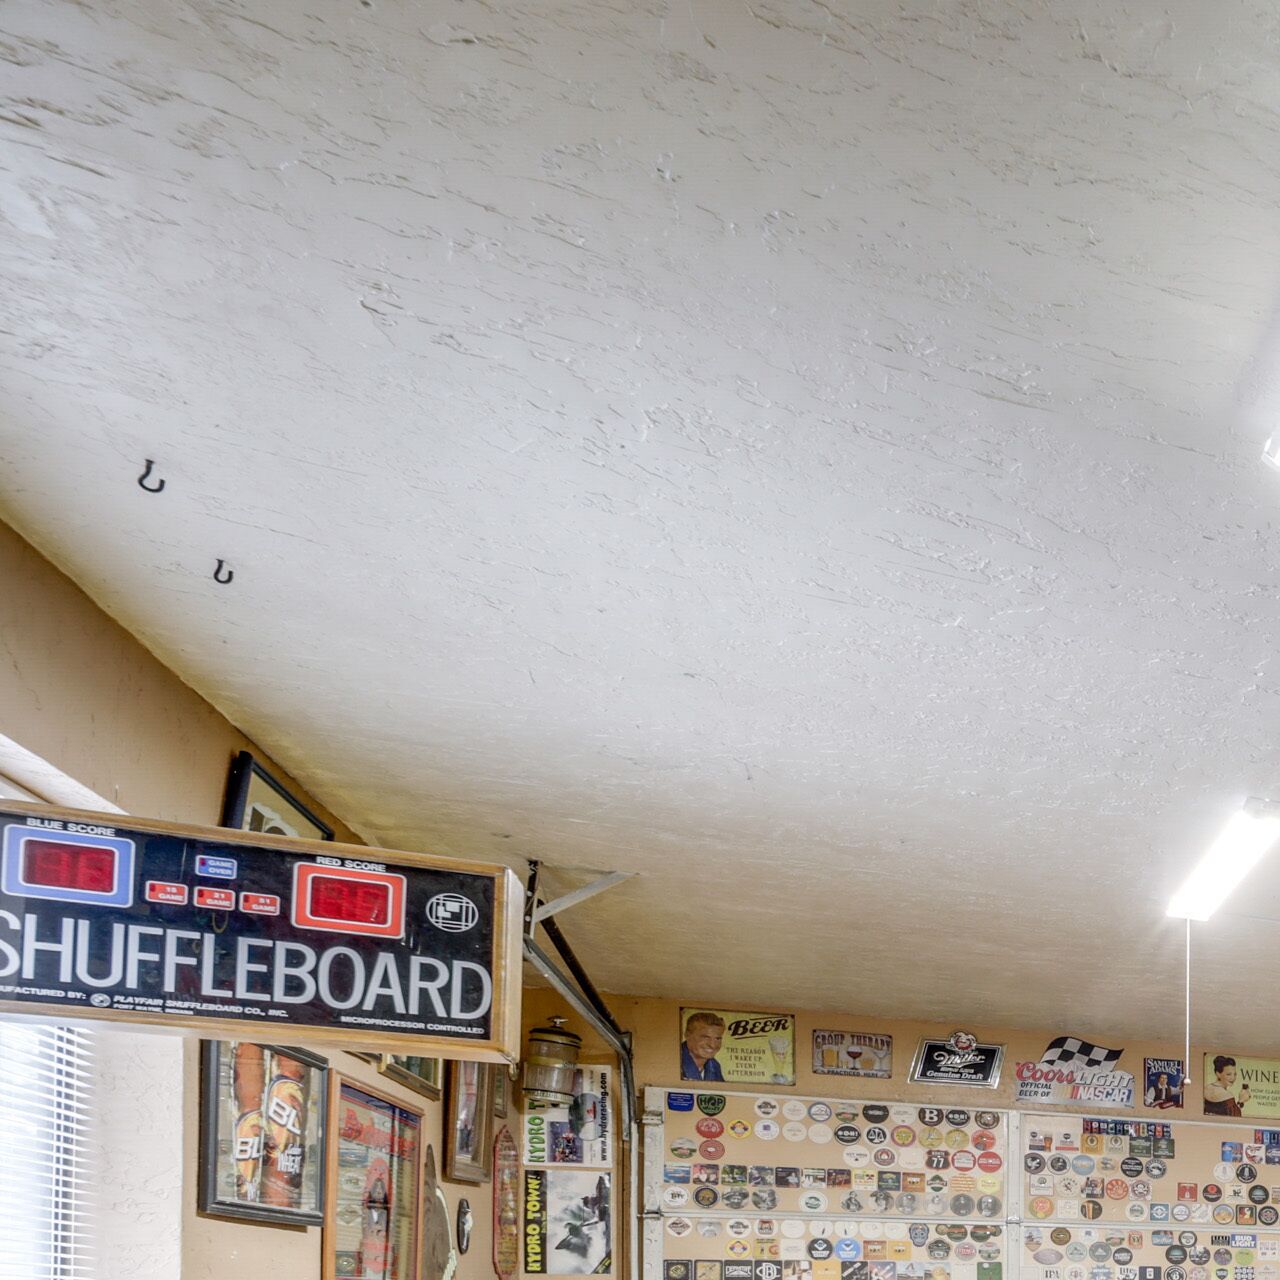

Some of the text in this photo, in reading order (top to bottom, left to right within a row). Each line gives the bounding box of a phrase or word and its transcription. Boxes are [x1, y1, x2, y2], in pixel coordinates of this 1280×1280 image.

[26, 818, 115, 837] BLUE SCORE
[208, 866, 232, 875] OVER
[316, 856, 387, 872] RED SCORE
[158, 893, 184, 901] GAME
[206, 898, 231, 907] GAME
[0, 985, 65, 997] UFACTURED
[67, 991, 86, 999] BY:
[113, 995, 164, 1006] PLAYFAIR
[165, 1000, 242, 1014] SHUFFLEBOARD
[341, 1015, 485, 1035] MICROPROCESSOR CONTROLLED
[728, 1016, 790, 1038] BEER
[815, 1034, 891, 1051] GROUP THERAPY
[726, 1047, 766, 1055] THE REASON
[932, 1051, 986, 1067] Miller
[1147, 1058, 1181, 1069] SAMUEL
[1149, 1066, 1177, 1075] ADAMS
[727, 1069, 766, 1077] AFTERNOON
[926, 1069, 957, 1078] Genuine
[959, 1071, 984, 1080] Draft
[1016, 1061, 1134, 1088] Coors LIGHT
[1076, 1086, 1132, 1103] NASCAR
[528, 1116, 545, 1163] HYDRO
[932, 1157, 944, 1168] 77
[527, 1174, 542, 1272] HYDRO TOWN!
[1045, 1270, 1060, 1279] IPA
